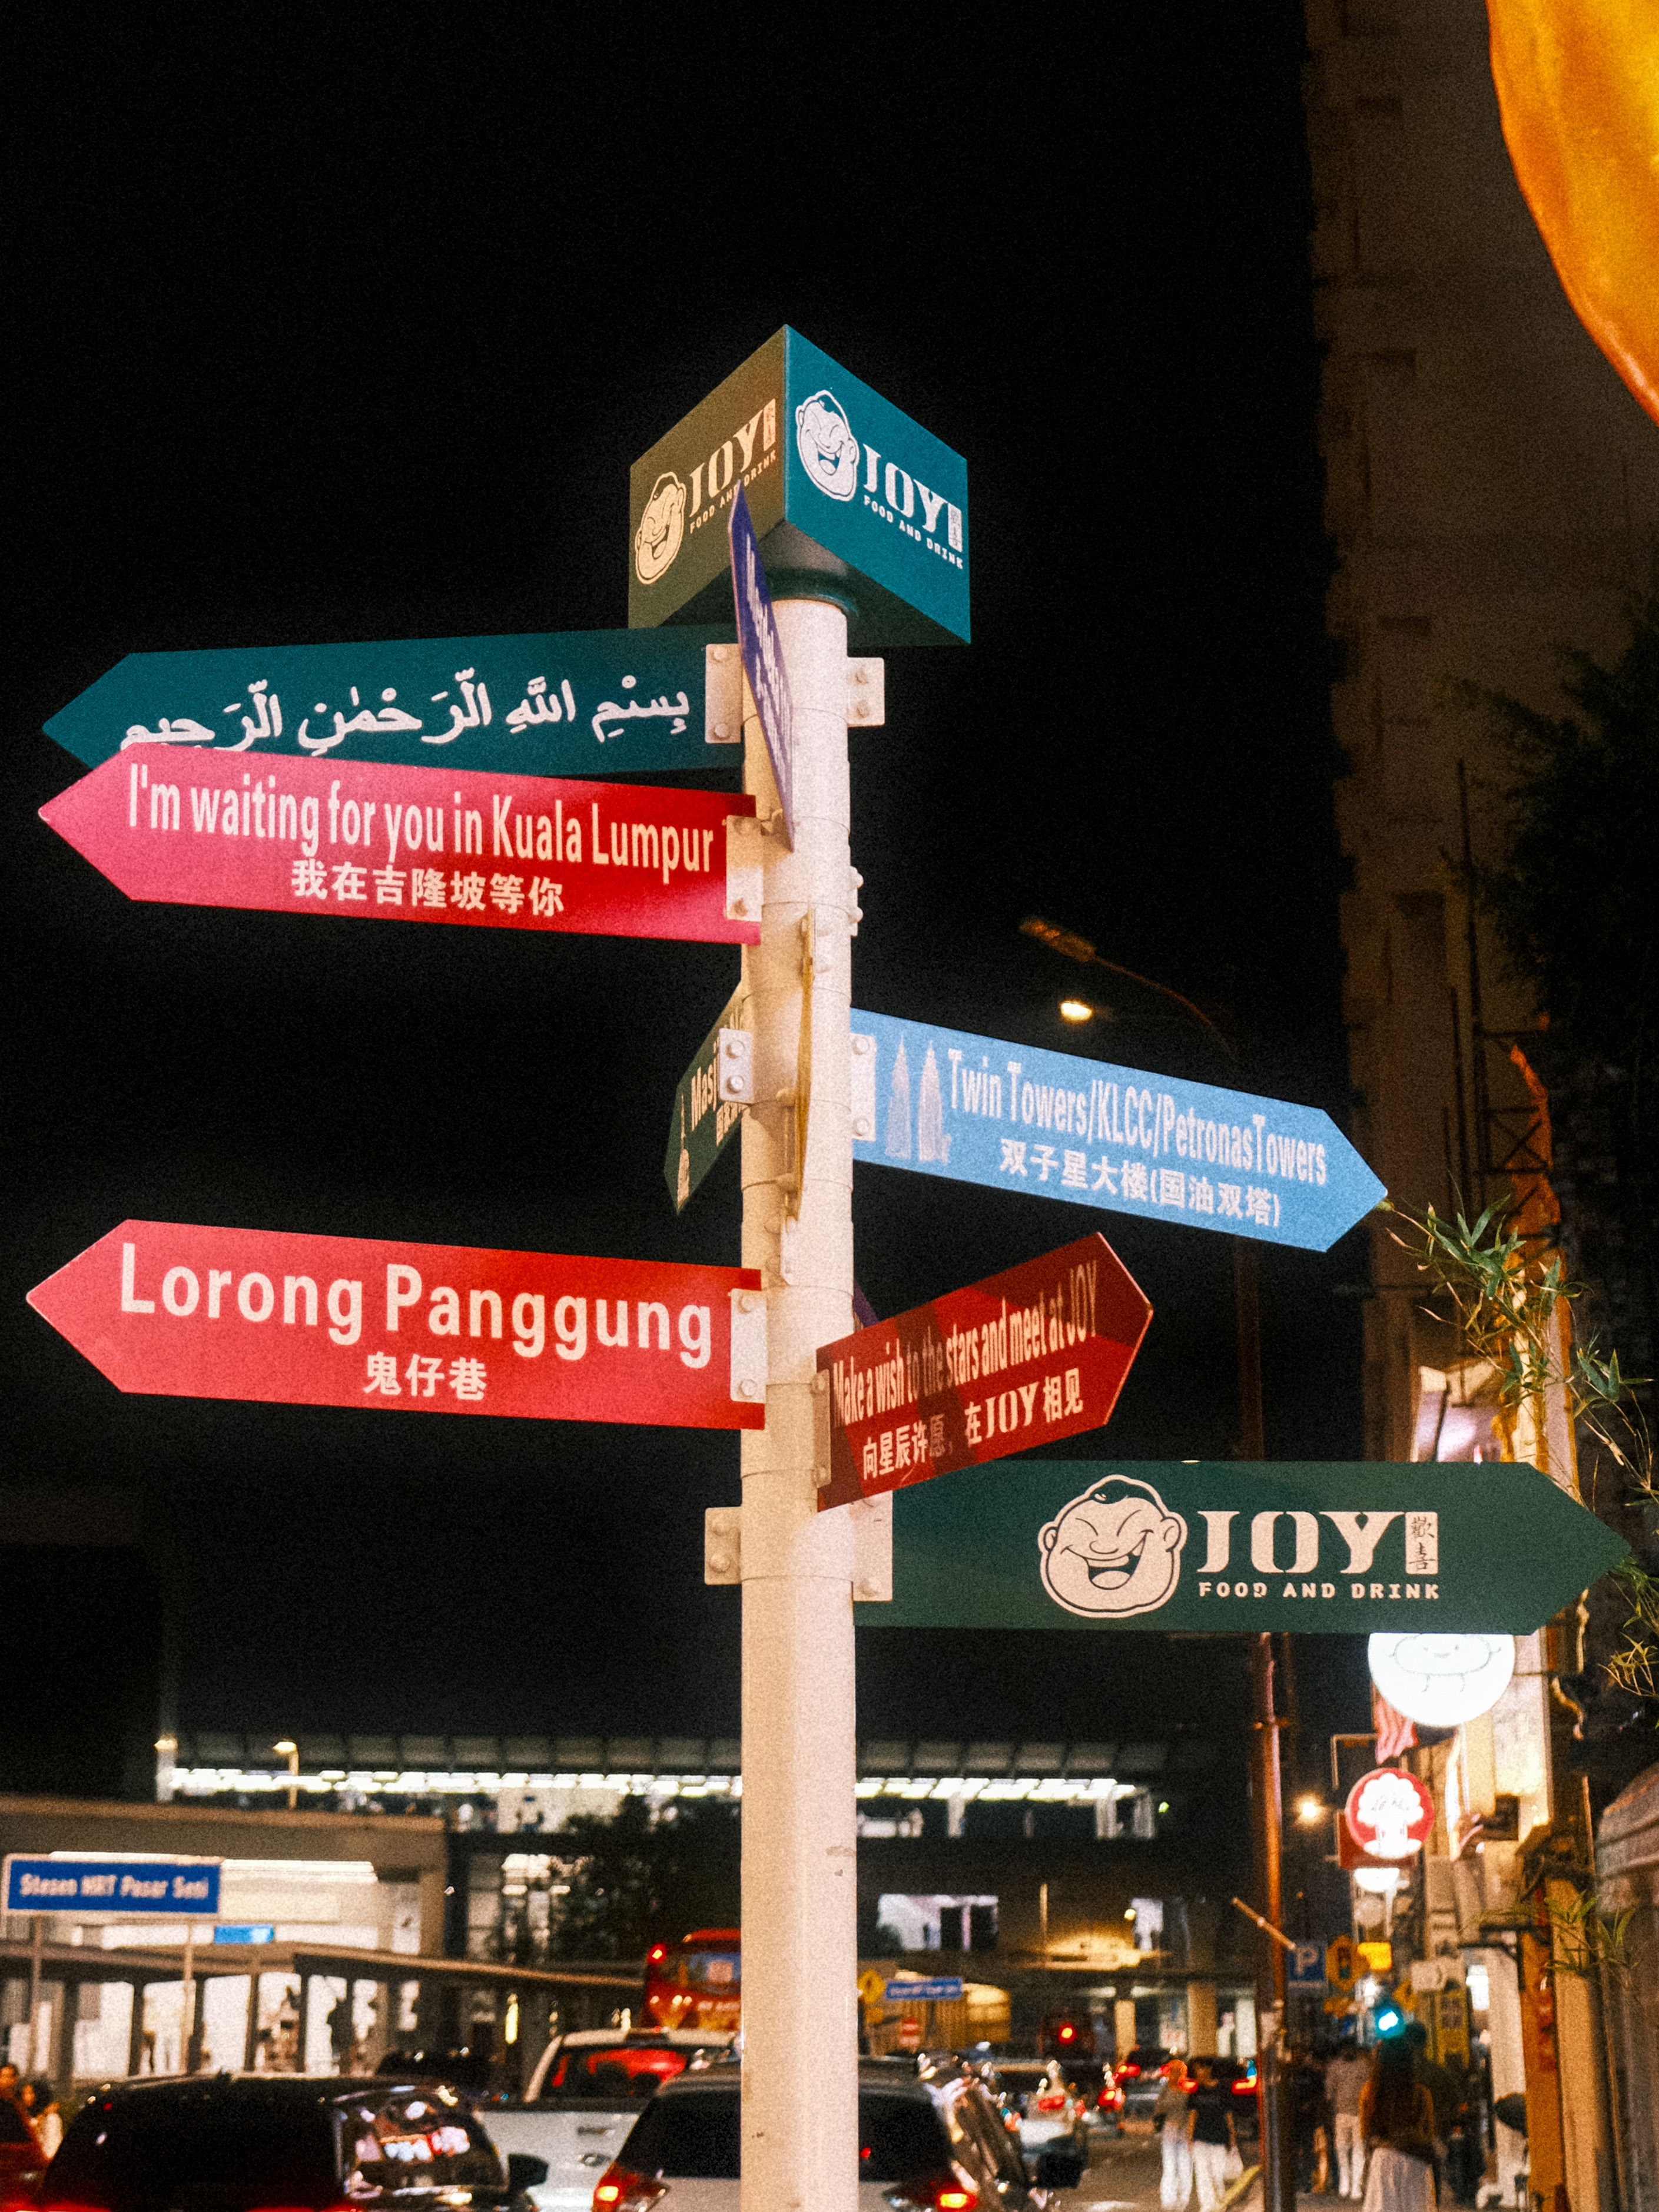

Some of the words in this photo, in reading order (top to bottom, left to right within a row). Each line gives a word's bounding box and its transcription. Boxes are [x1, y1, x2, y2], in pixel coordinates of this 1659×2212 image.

[689, 409, 764, 518] JOY
[690, 505, 715, 534] FOOD
[744, 449, 776, 487] DRINK
[863, 443, 948, 533] JOY
[864, 495, 894, 523] FOOD
[899, 520, 921, 542] AND
[927, 538, 963, 569] DRINK
[130, 764, 180, 831] I'm
[191, 773, 319, 857] waiting
[328, 780, 376, 846] for
[384, 802, 443, 864] you
[454, 791, 483, 855] in
[493, 795, 582, 863] Kuala
[592, 803, 714, 885] Lumpur
[291, 858, 564, 917] 我在吉隆坡等你
[948, 1048, 1002, 1119] Twin
[121, 1242, 363, 1345] Lorong
[386, 1263, 712, 1369] Panggung
[833, 1356, 864, 1428] Make
[866, 1368, 874, 1418] a
[875, 1338, 904, 1413] wish
[905, 1341, 919, 1404] to
[922, 1326, 943, 1397] the
[946, 1324, 979, 1387] stars
[981, 1296, 1007, 1377] and
[1009, 1291, 1047, 1366] meet
[1049, 1282, 1065, 1353] at
[1066, 1259, 1097, 1347] JOY
[363, 1351, 489, 1401] 鬼仔巷
[1197, 1511, 1406, 1574] JOY
[1198, 1581, 1268, 1598] FOOD
[1282, 1582, 1336, 1599] AND
[1351, 1583, 1440, 1600] DRINK
